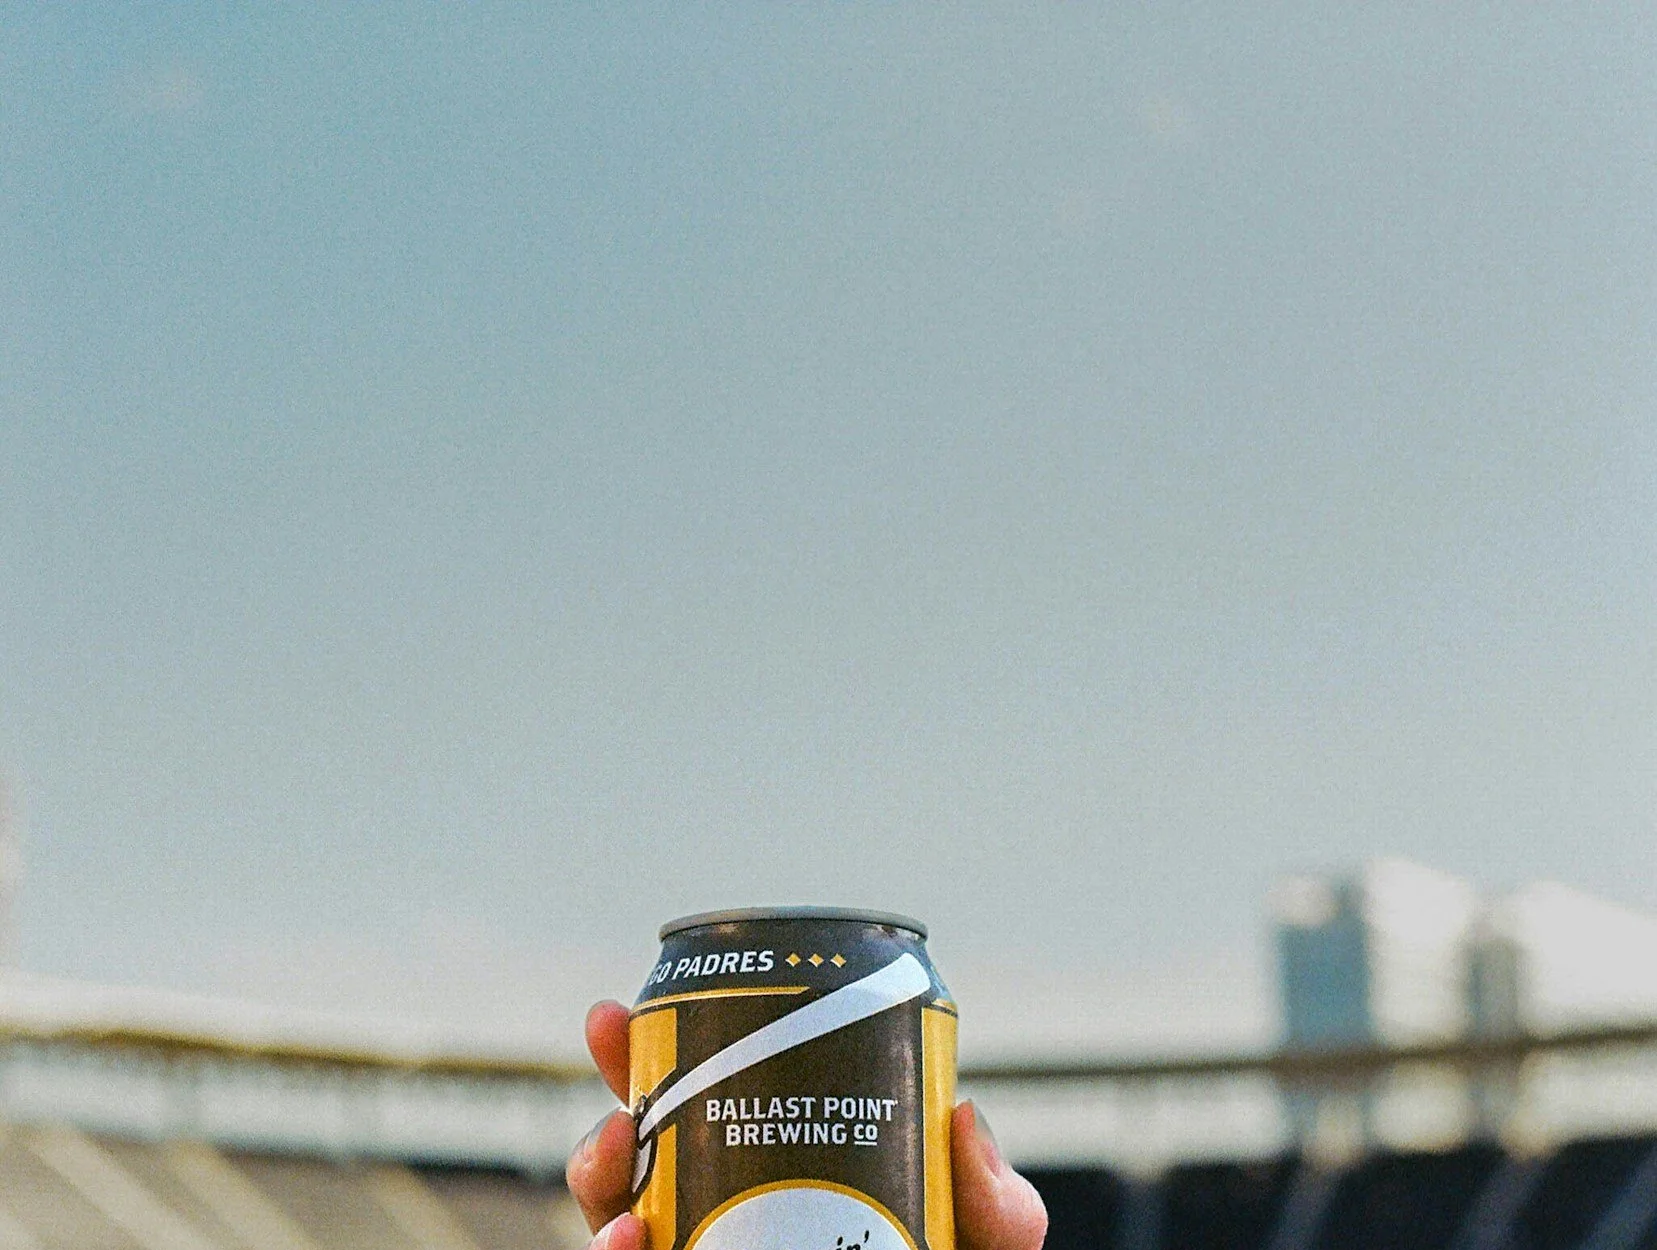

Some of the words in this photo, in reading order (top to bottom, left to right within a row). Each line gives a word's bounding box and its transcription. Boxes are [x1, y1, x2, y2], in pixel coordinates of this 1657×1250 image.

[671, 950, 774, 980] PADRES
[706, 1097, 817, 1122] BALLAST
[824, 1097, 896, 1121] POINT
[726, 1123, 848, 1146] BREWING
[853, 1124, 878, 1145] CO
